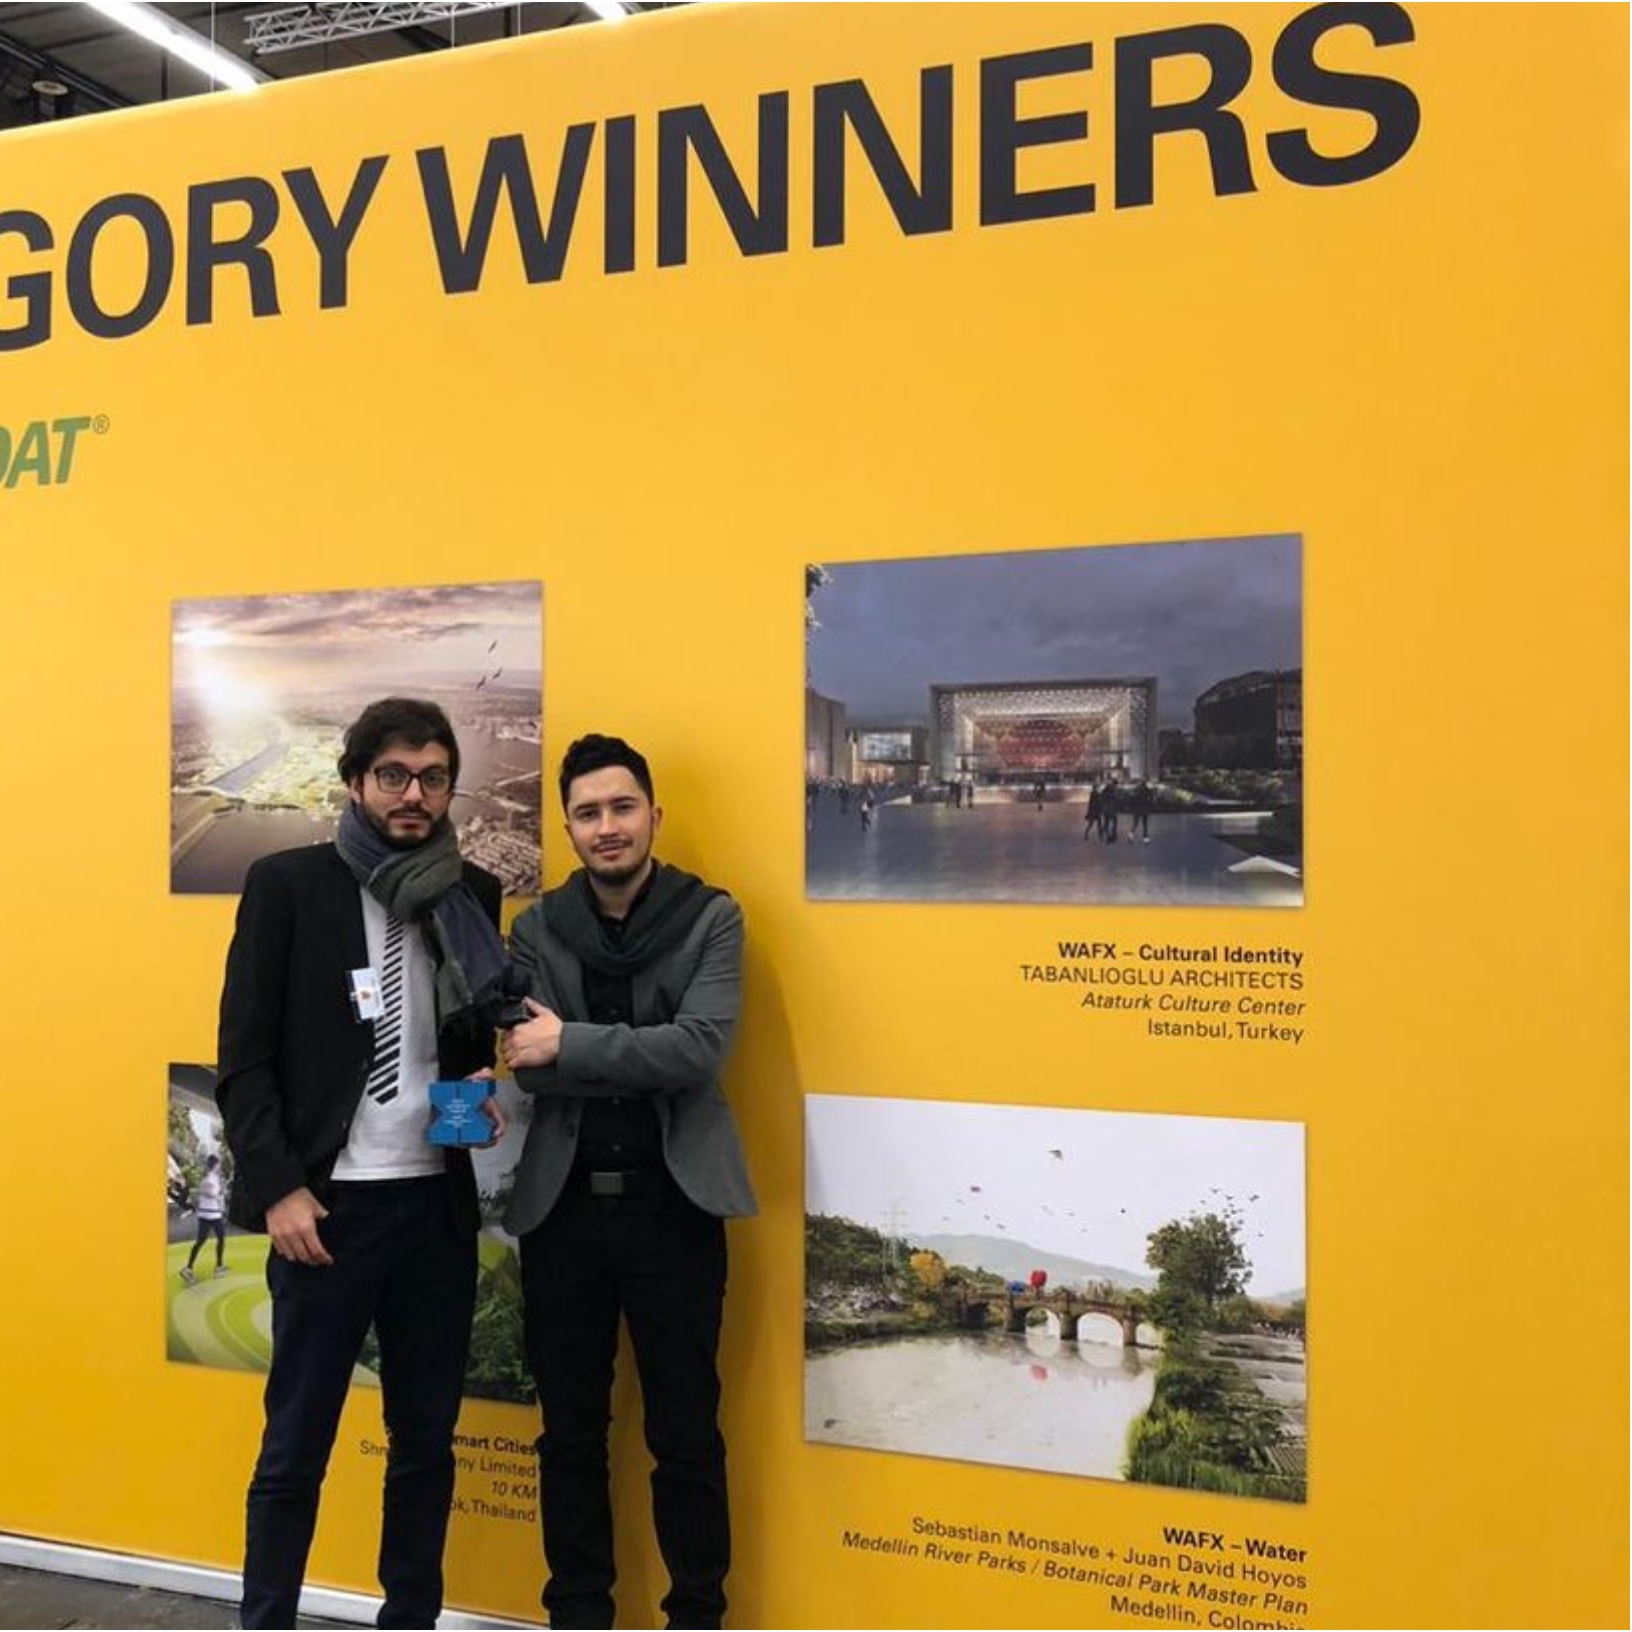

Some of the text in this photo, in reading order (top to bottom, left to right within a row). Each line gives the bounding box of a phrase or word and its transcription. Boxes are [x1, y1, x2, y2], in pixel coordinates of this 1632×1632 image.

[415, 2, 1421, 295] WINNERS
[1058, 942, 1116, 960] WAFX
[1139, 943, 1218, 963] Cultural
[1224, 946, 1304, 968] Identity
[1020, 965, 1304, 991] TABANLIOGLU ARCHITECTS
[1081, 992, 1306, 1015] Ataturk Culture Center
[1148, 1018, 1305, 1045] Istanbul, Turkey
[453, 1435, 489, 1449] mart
[480, 1457, 536, 1477] Limited
[492, 1480, 537, 1500] 10 KM
[471, 1498, 536, 1522] Thailand
[912, 1516, 1001, 1546] Sebastian
[1007, 1530, 1100, 1561] Monsalve
[1123, 1547, 1170, 1569] Juan
[1177, 1555, 1235, 1580] David
[1241, 1565, 1308, 1591] Hoyos
[1162, 1526, 1224, 1552] WAFX
[1244, 1537, 1308, 1564] Water
[841, 1530, 919, 1558] Medellin
[924, 1543, 971, 1565] River
[976, 1551, 1027, 1574] Parks
[1043, 1559, 1135, 1589] Botanical
[1138, 1574, 1181, 1597] Park
[1186, 1581, 1259, 1609] Master
[1262, 1592, 1309, 1617] Plan
[1110, 1595, 1202, 1627] Medellin,
